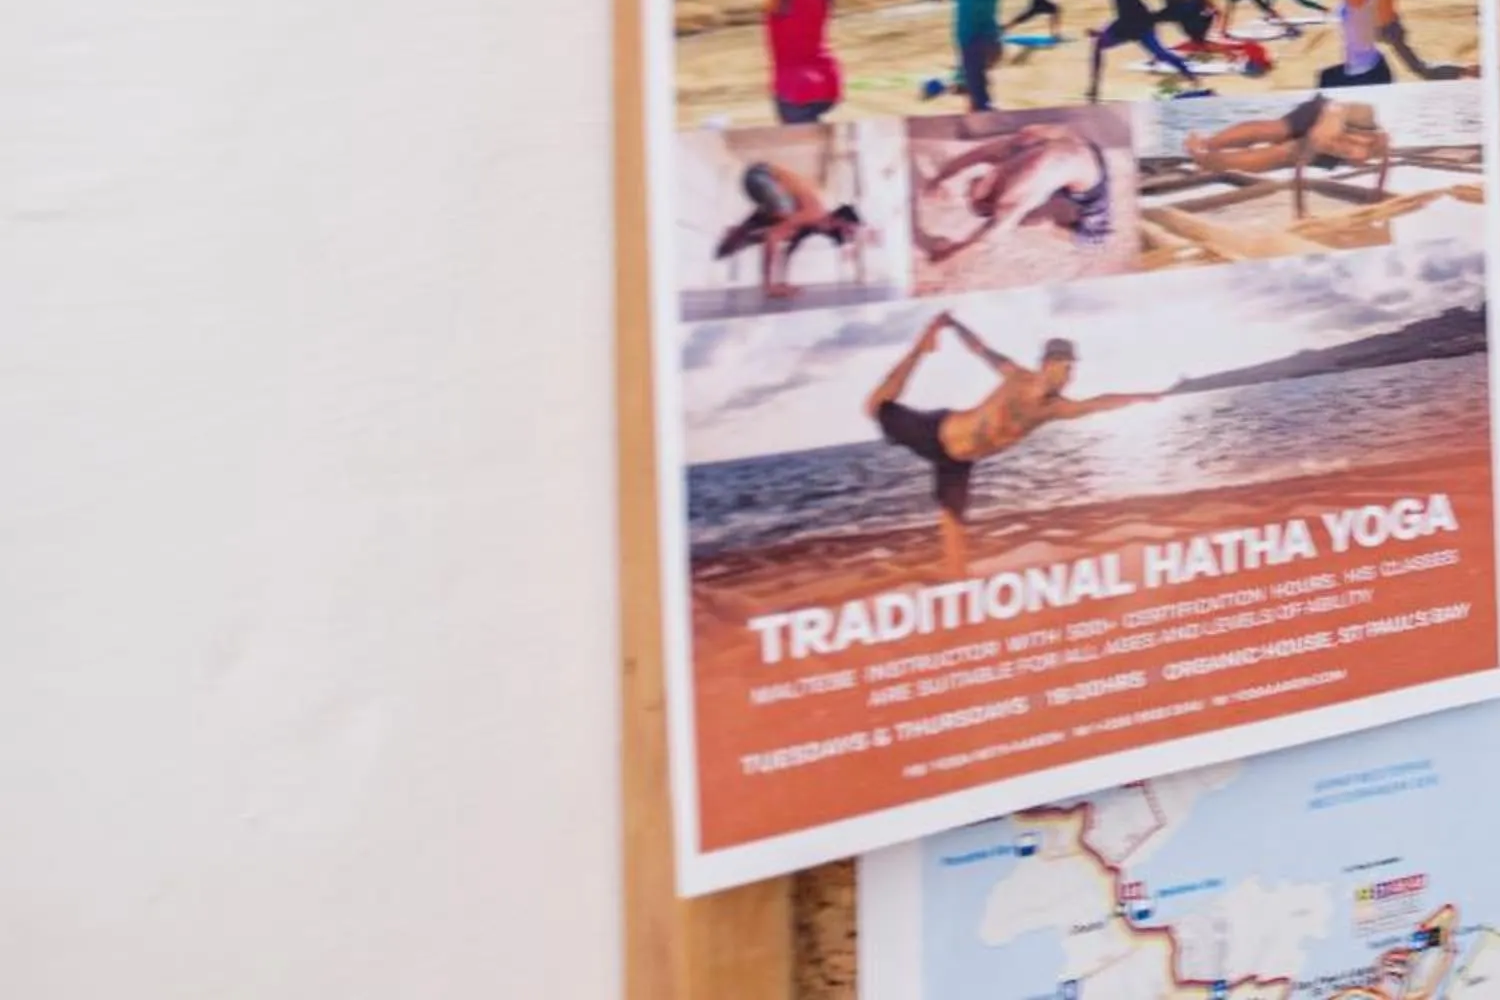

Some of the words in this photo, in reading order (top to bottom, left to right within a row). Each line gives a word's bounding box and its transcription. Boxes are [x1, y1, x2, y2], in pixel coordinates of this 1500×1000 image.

[747, 552, 1136, 665] TRADITIONAL
[1142, 519, 1318, 588] HATHA
[1321, 493, 1460, 552] YOGA
[749, 669, 857, 706] MALTESE
[864, 641, 1001, 683] INSTRUCTOR
[1005, 629, 1063, 653] WITH
[1378, 549, 1462, 578] CLASSES
[1103, 632, 1160, 656] AGES
[1202, 609, 1276, 637] LEVELS
[740, 731, 872, 775] TUESDAYS
[872, 727, 893, 748] &
[893, 694, 1031, 742] THURSDAYS
